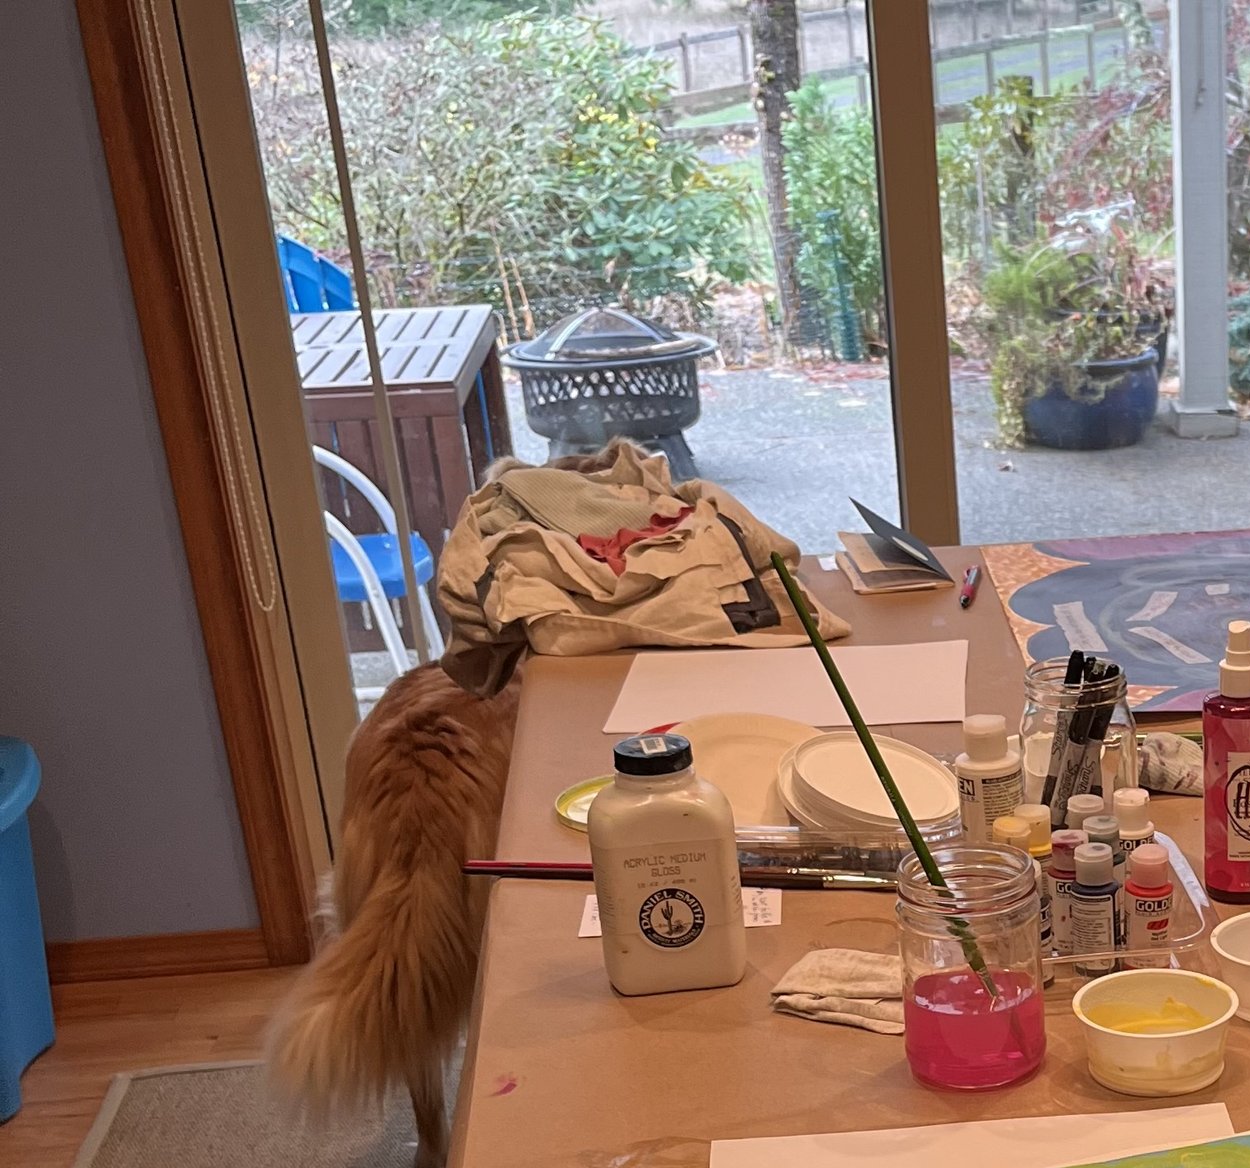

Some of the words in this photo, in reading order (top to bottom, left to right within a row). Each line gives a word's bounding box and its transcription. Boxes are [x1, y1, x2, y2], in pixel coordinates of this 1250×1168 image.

[623, 855, 666, 869] ACRYLIC
[669, 852, 707, 864] MEDIUM
[651, 866, 681, 878] GLOSS
[641, 890, 673, 930] DANIEL
[674, 890, 704, 924] SMITH
